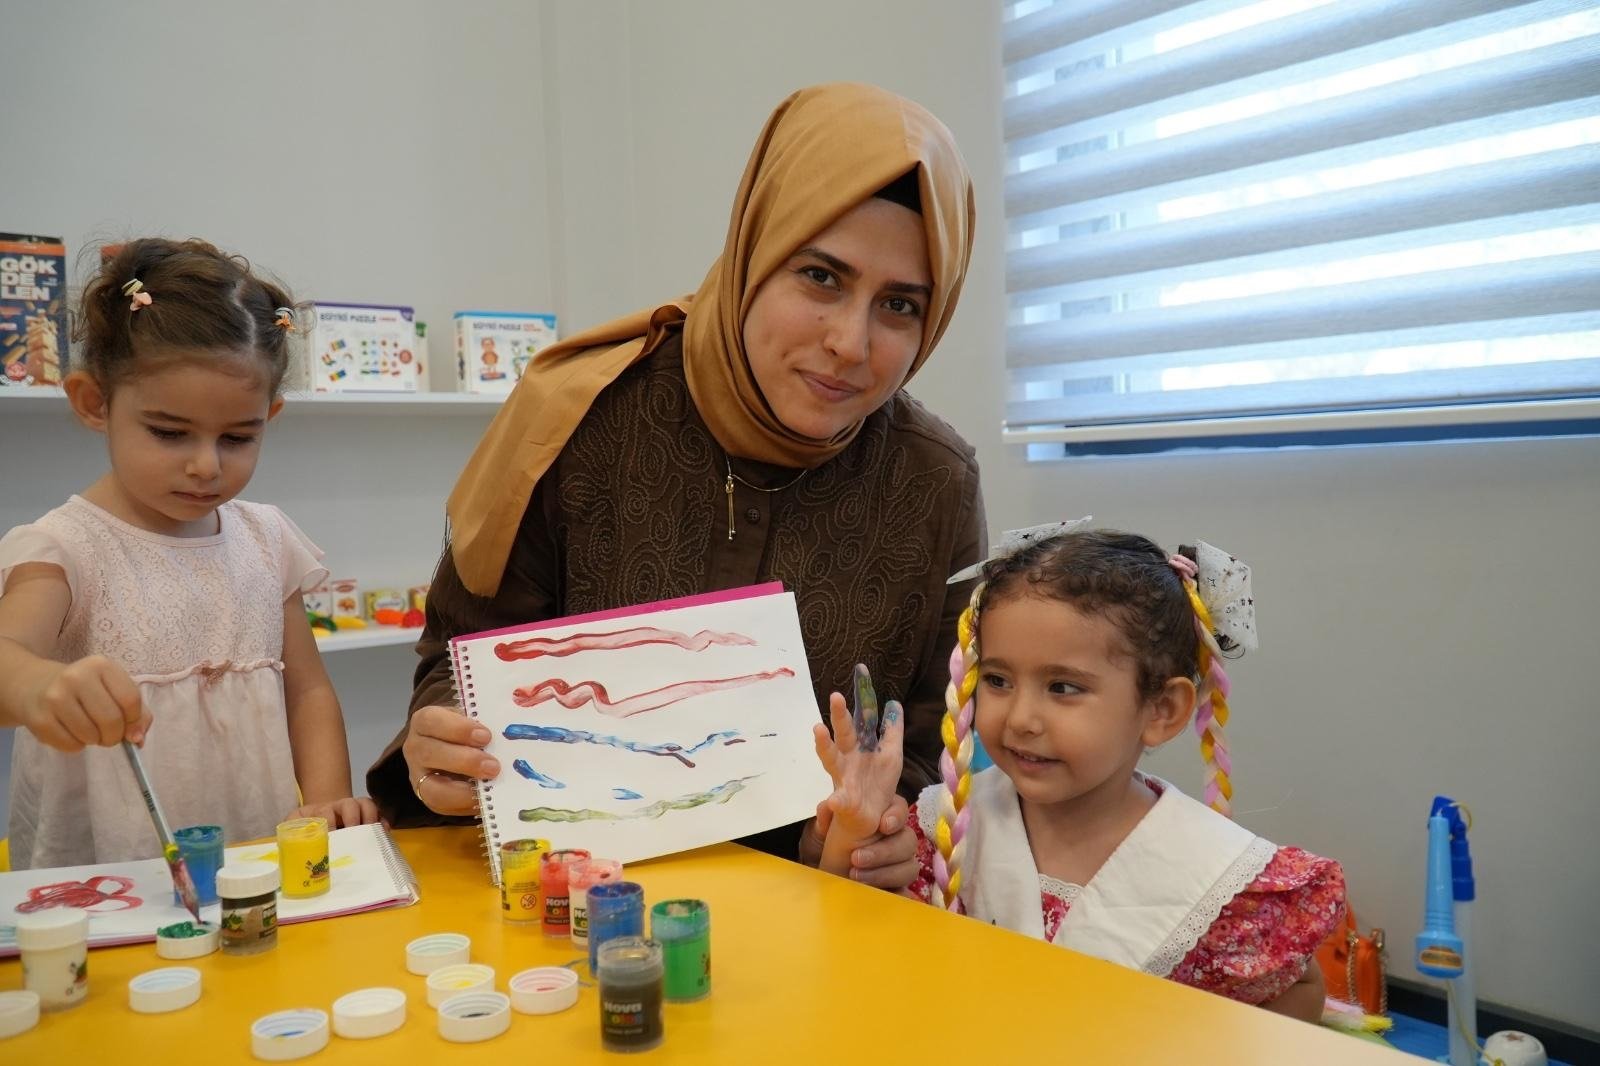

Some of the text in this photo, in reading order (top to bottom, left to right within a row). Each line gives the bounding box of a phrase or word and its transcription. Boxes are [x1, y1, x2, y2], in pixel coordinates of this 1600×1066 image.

[0, 254, 58, 275] GÖK
[1, 272, 36, 287] DE
[1, 286, 50, 301] LEN
[546, 898, 569, 907] Nov
